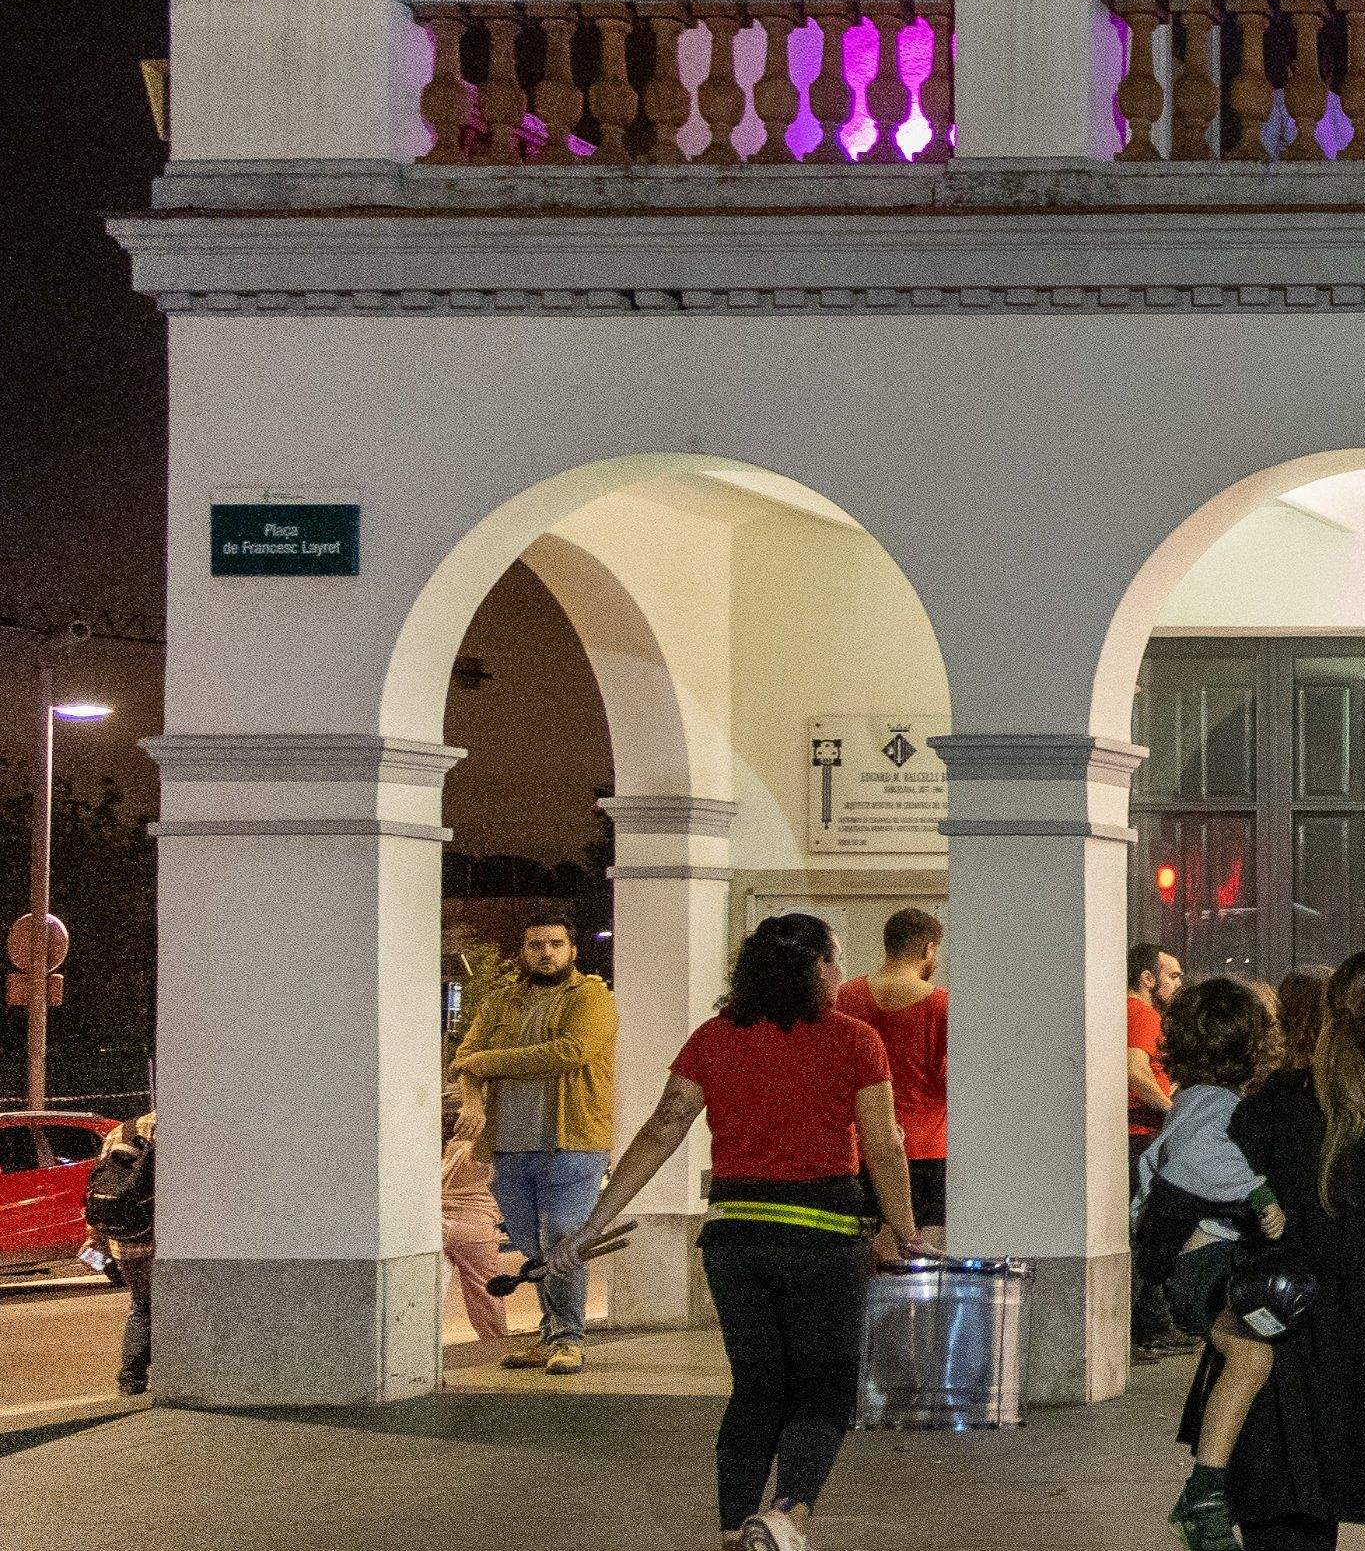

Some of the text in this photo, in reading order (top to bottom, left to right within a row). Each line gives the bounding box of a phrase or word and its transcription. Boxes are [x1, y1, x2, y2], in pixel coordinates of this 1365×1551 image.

[263, 522, 299, 540] Plaça
[222, 540, 341, 557] de Francesc Layret
